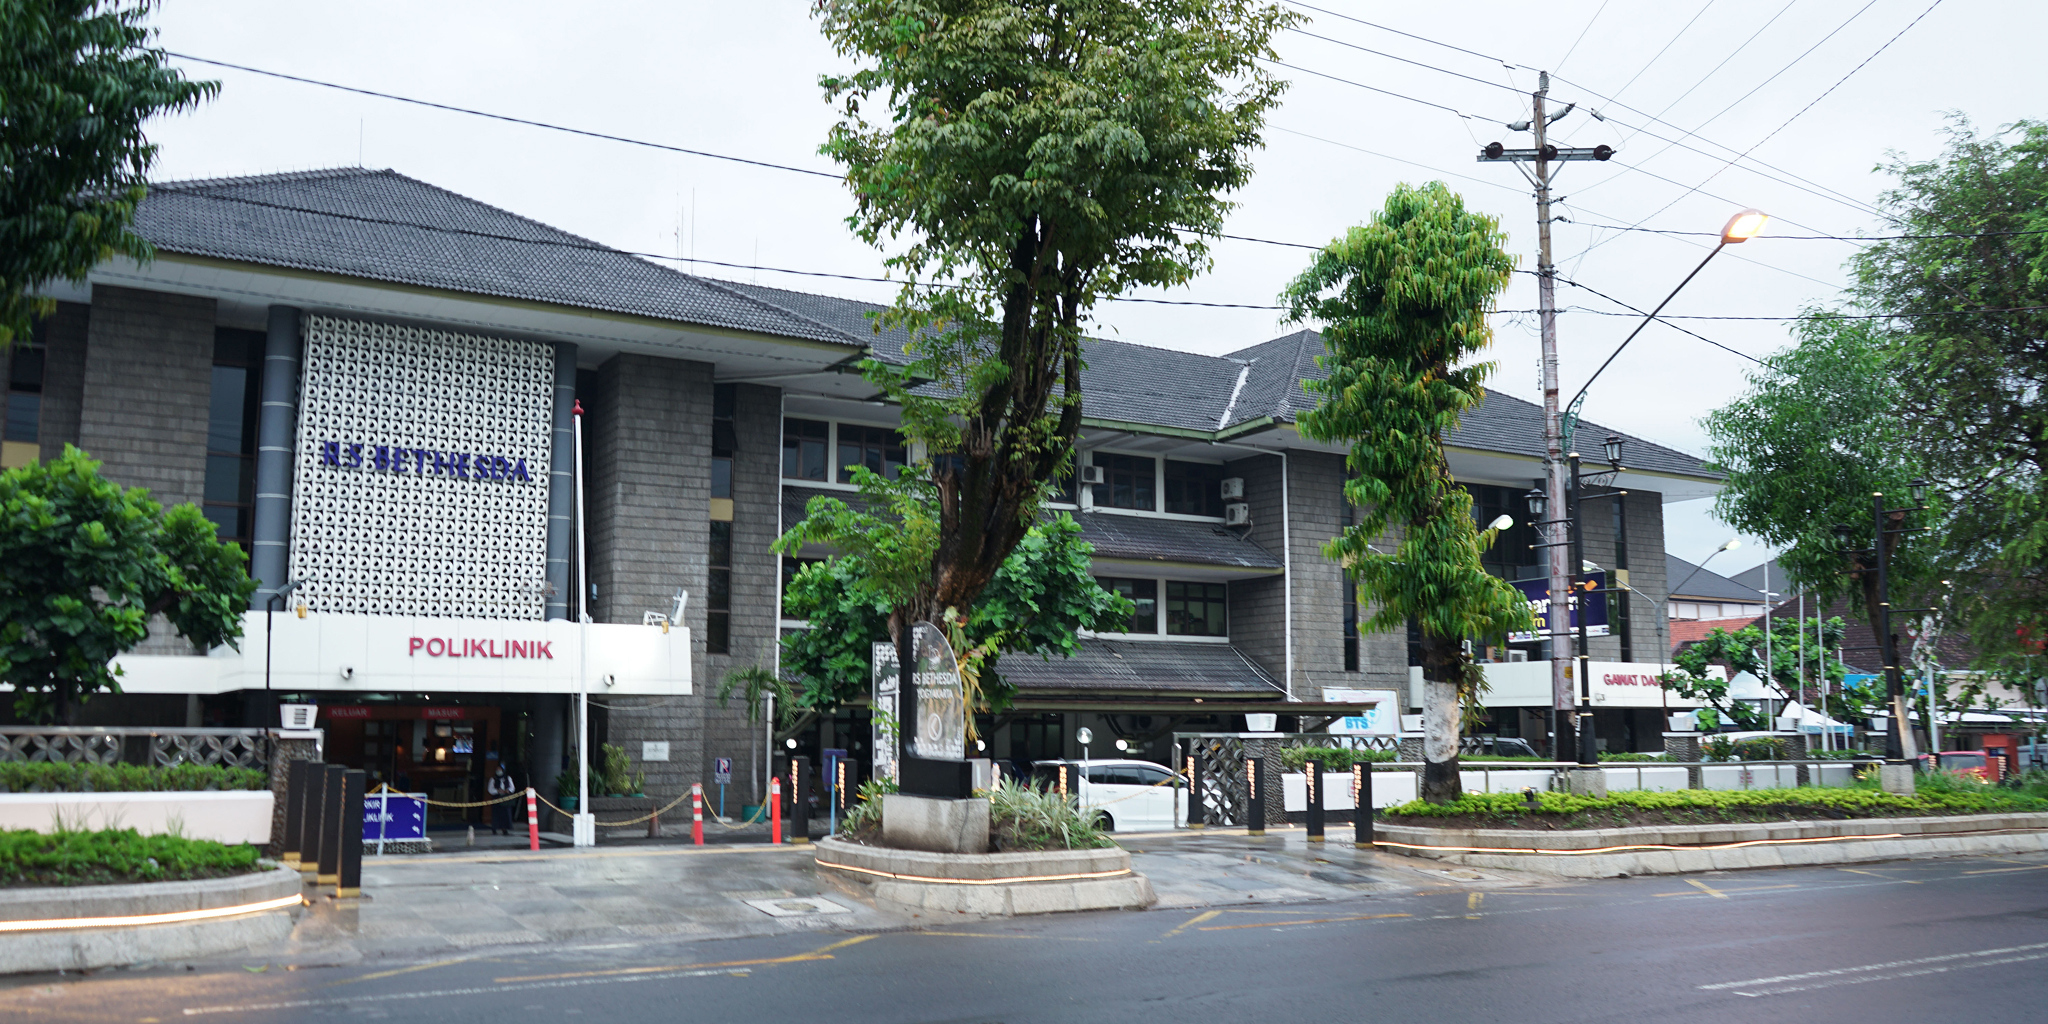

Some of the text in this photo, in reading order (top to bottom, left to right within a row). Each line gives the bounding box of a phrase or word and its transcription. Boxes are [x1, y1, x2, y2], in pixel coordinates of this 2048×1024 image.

[323, 440, 531, 482] RS BETHESDA
[409, 637, 554, 659] POLIKLINIK
[912, 672, 958, 685] RS BETHESDA
[1603, 673, 1639, 687] GAWAT
[916, 688, 954, 700] YOGYAKARTA
[331, 708, 368, 718] KELUAR
[428, 708, 459, 718] MASUK
[1345, 716, 1369, 729] BTS
[364, 799, 381, 810] RKIR
